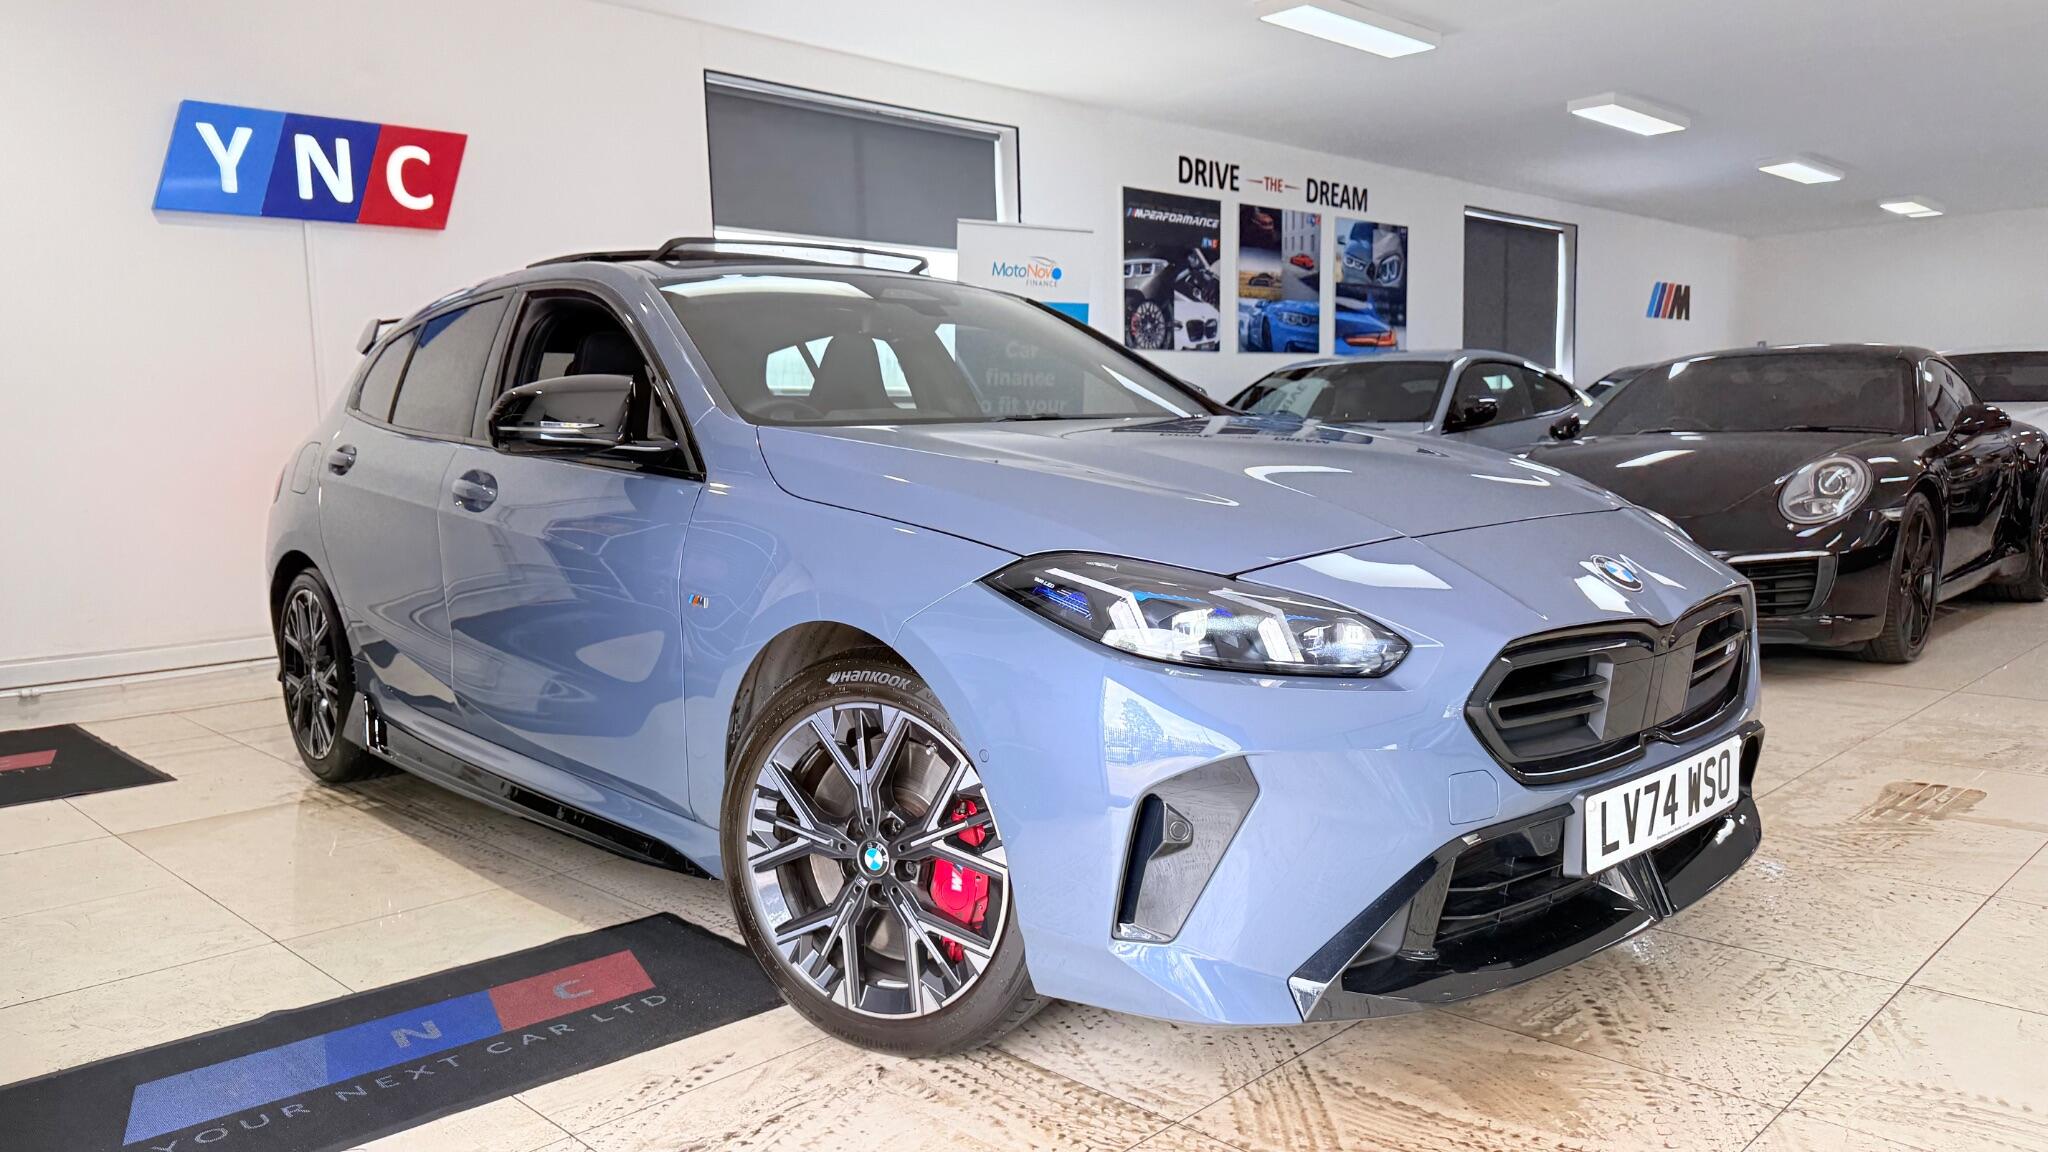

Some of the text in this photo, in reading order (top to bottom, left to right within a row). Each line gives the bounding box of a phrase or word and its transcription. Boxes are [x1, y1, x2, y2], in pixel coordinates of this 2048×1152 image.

[196, 121, 434, 210] YNC
[1178, 156, 1368, 212] DRIVE THE DREAM
[985, 367, 1055, 387] finance
[1005, 341, 1039, 359] Car
[1601, 749, 1731, 857] LV74 WSO
[151, 995, 667, 1152] YOUR NEXT CAR LTD
